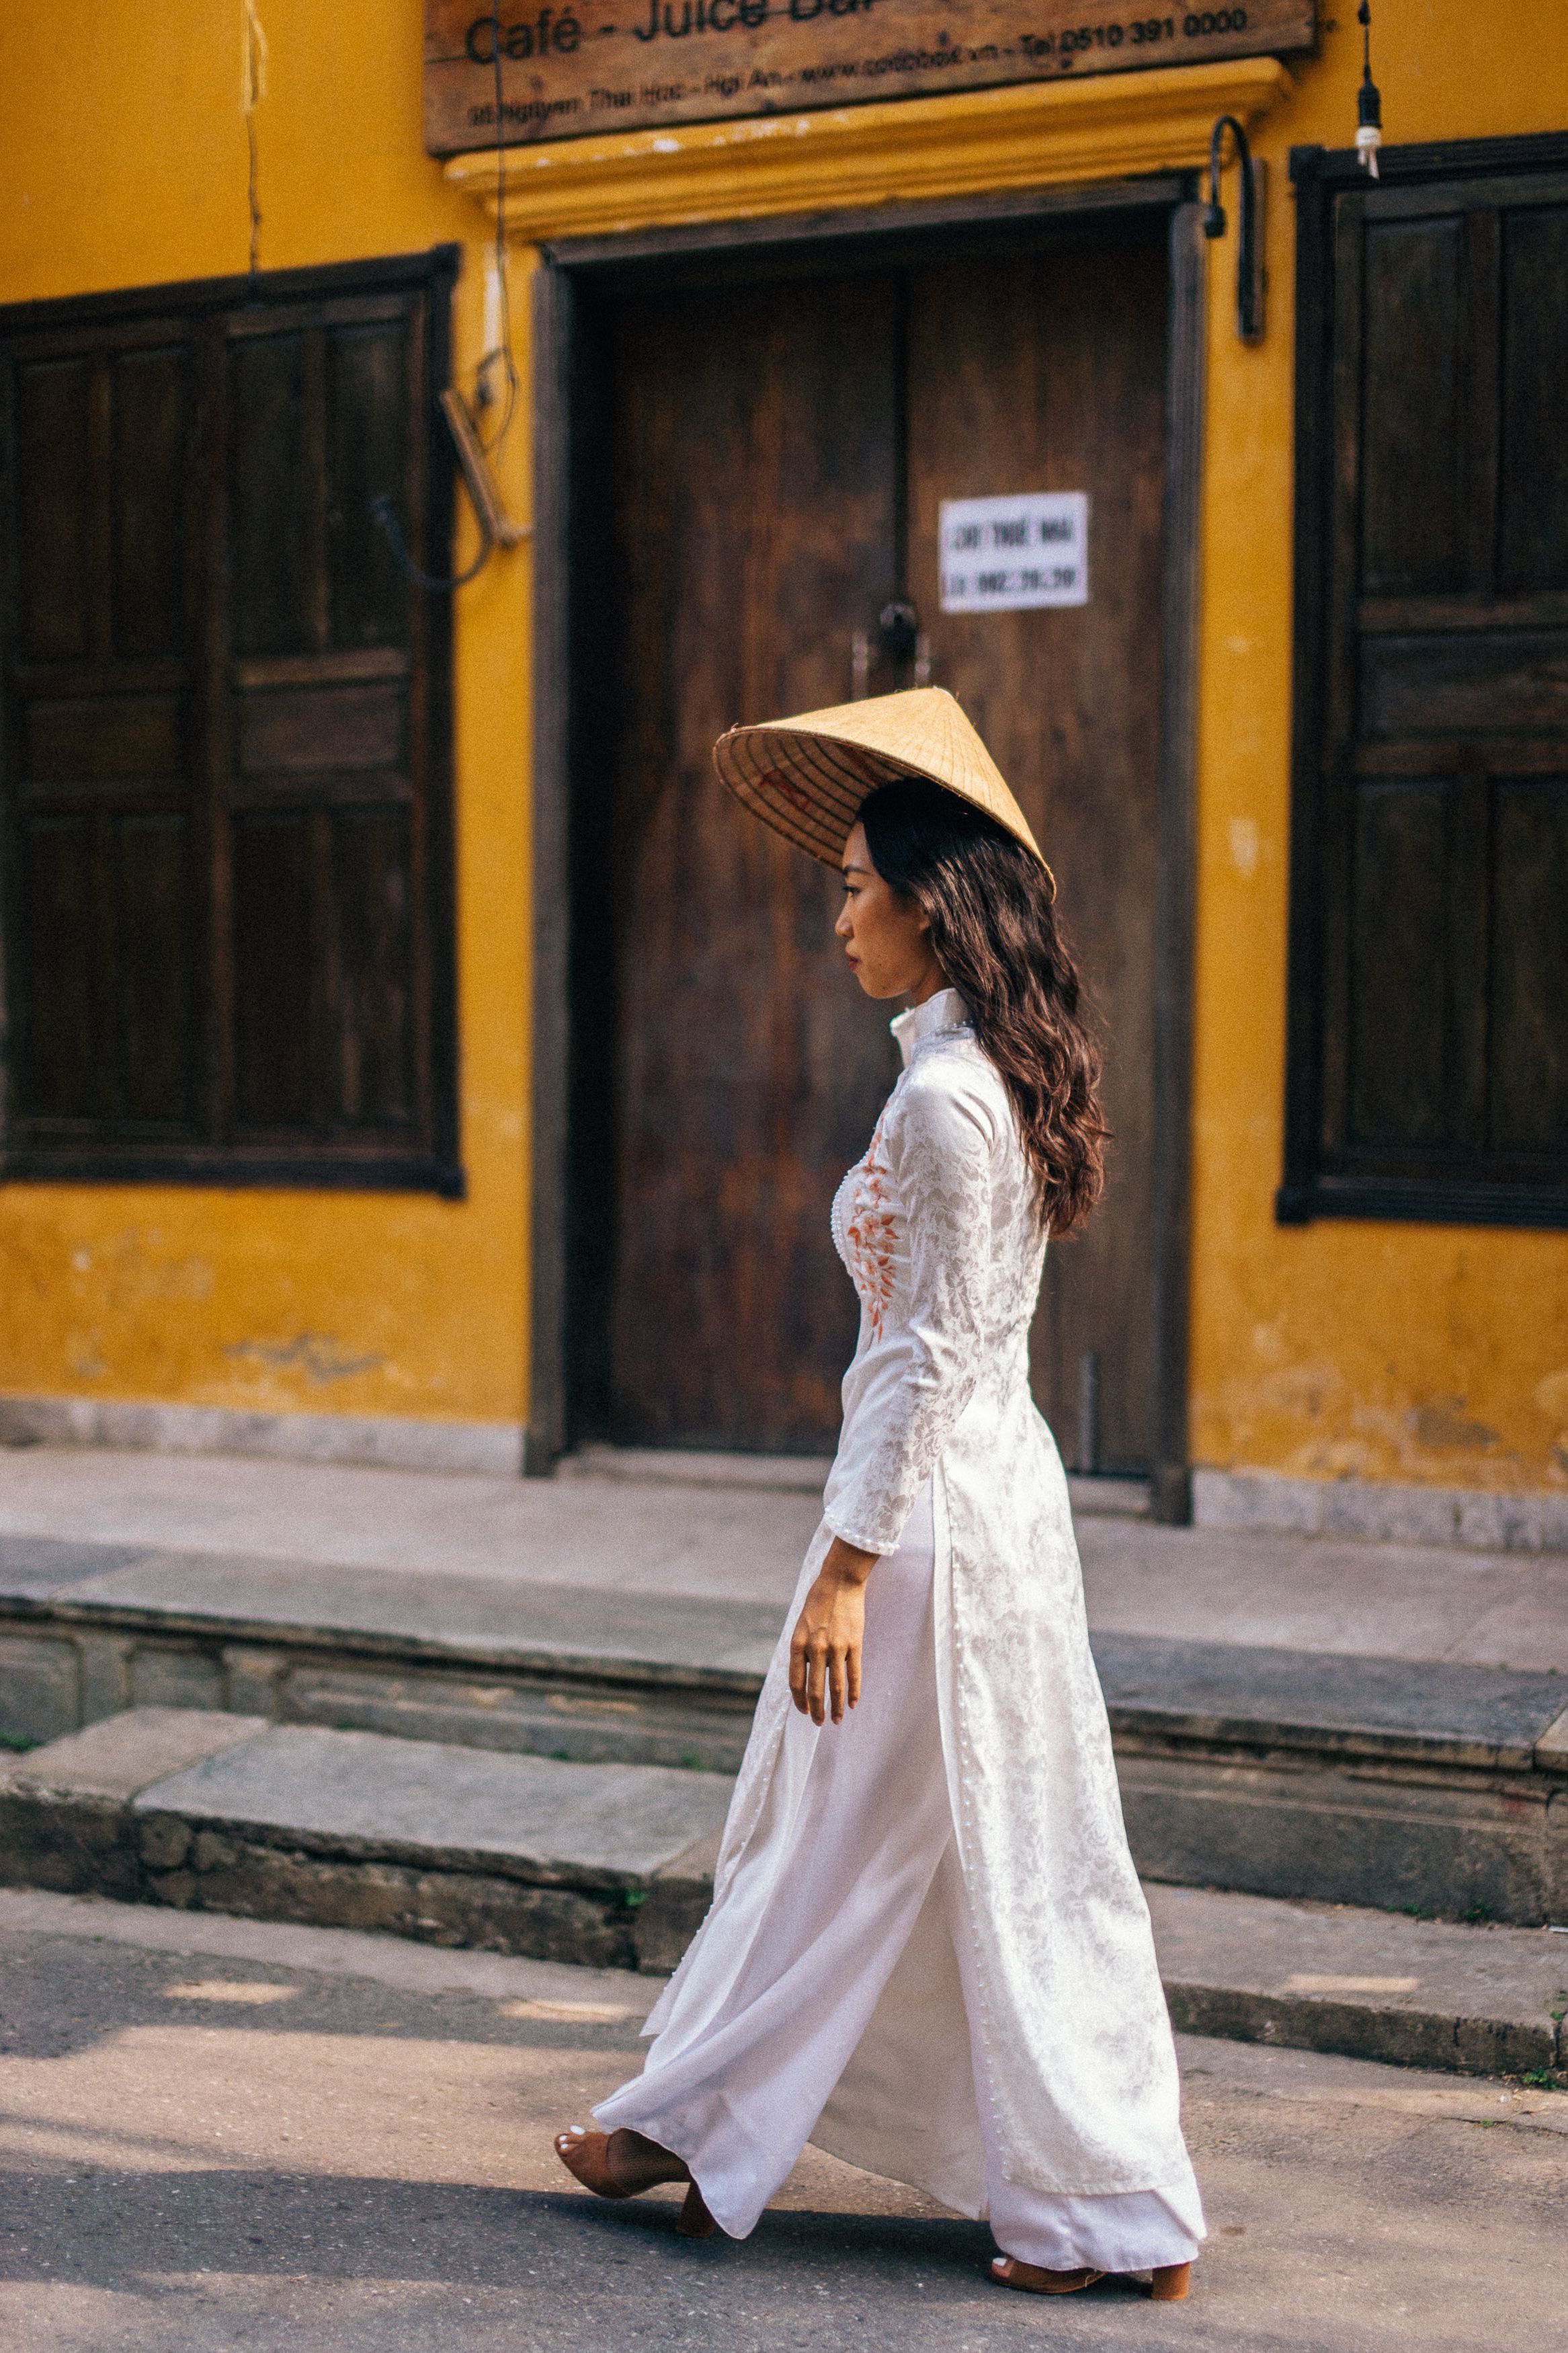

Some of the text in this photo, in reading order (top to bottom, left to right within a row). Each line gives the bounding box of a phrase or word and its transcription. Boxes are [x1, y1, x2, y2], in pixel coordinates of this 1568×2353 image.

[465, 6, 581, 65] Café
[634, 0, 766, 41] Juice
[1059, 24, 1124, 53] 0510
[1130, 17, 1174, 44] 391
[1184, 9, 1247, 37] 0000
